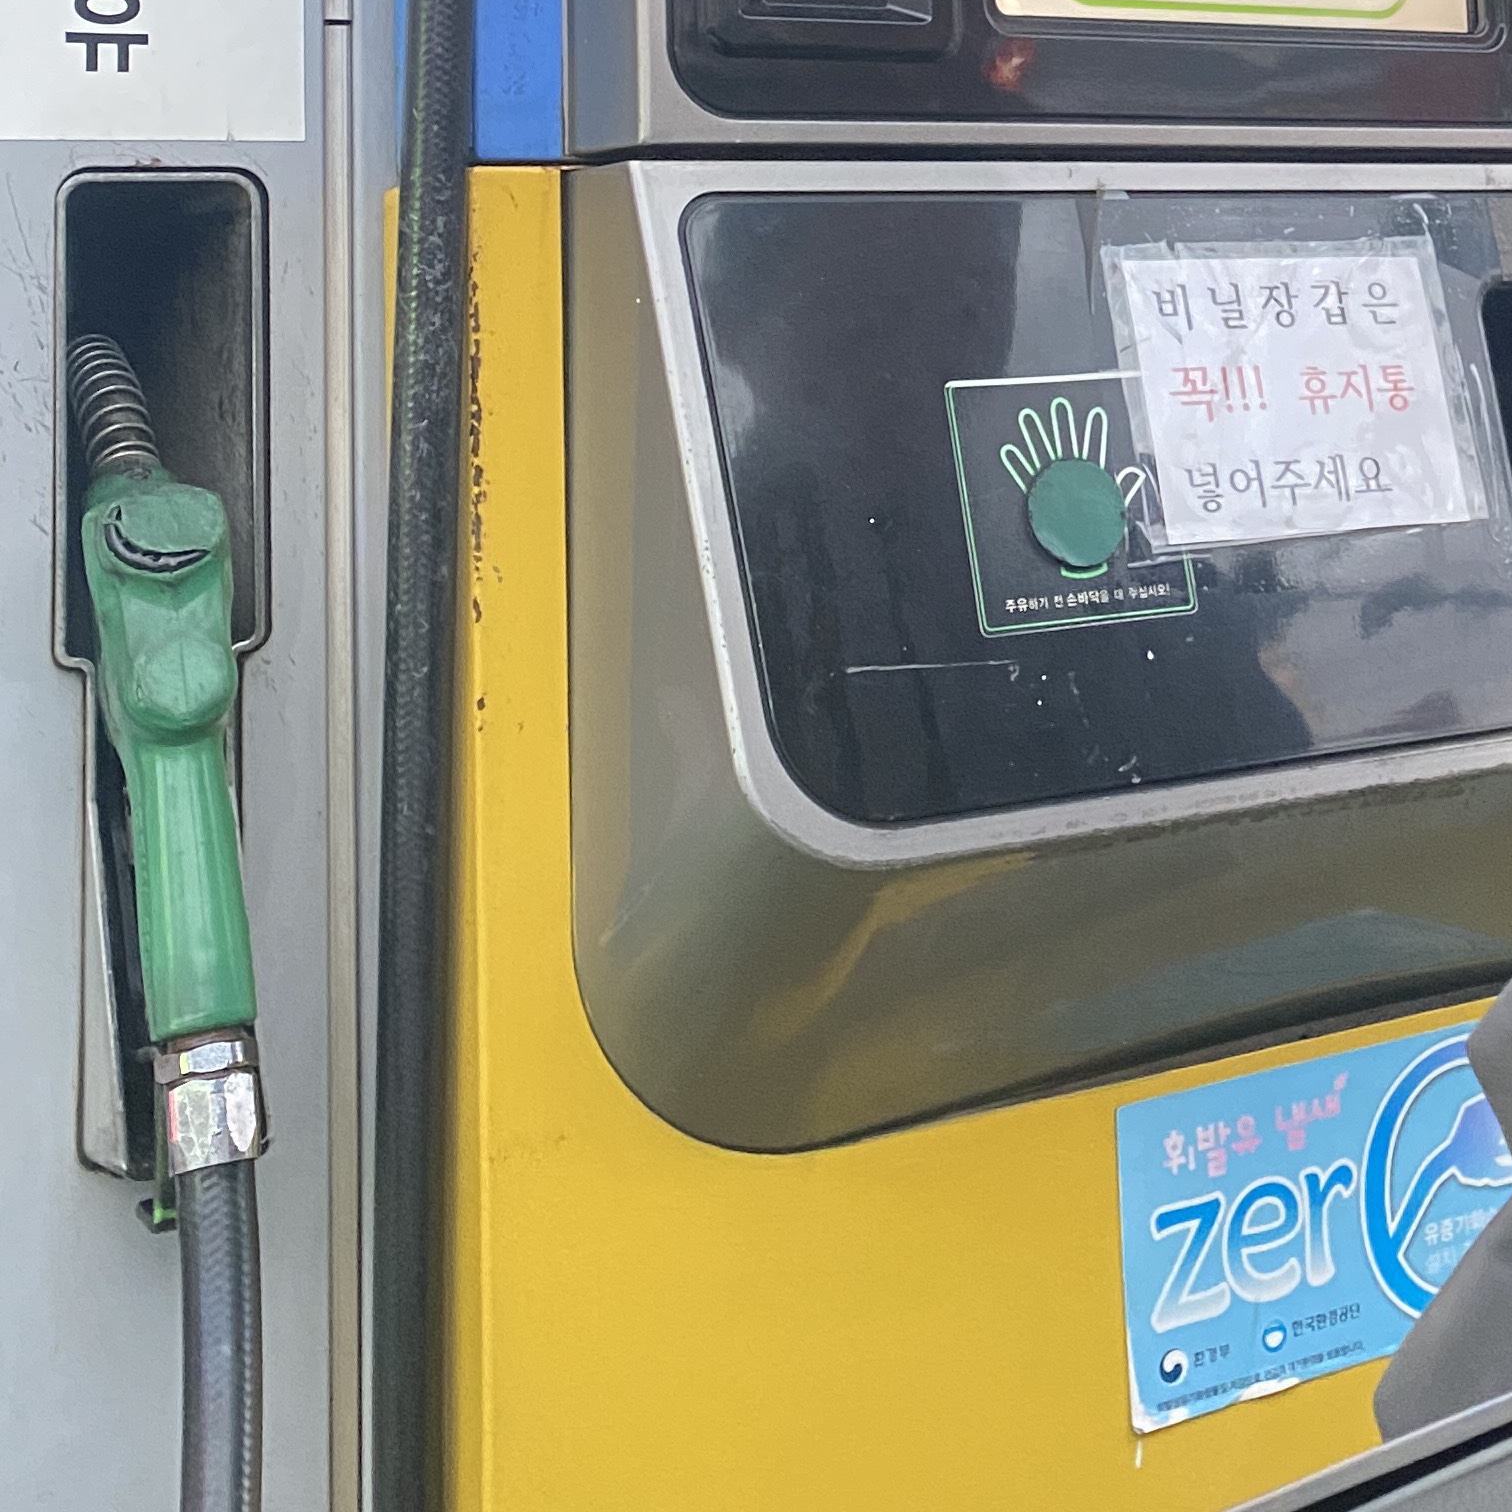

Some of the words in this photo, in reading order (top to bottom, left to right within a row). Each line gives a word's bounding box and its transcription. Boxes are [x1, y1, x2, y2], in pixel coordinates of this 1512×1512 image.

[1169, 365, 1268, 423] 꼭!!!
[1299, 364, 1415, 414] 휴지통
[1185, 454, 1393, 514] 넣어주세요
[1005, 596, 1049, 614] 주유하기
[1066, 589, 1110, 608] 손바닥을
[1163, 1115, 1262, 1178] 휘발유
[1275, 1072, 1348, 1152] 냄새
[1291, 1302, 1361, 1338] 한국환경공단
[1193, 1343, 1231, 1368] 환경부
